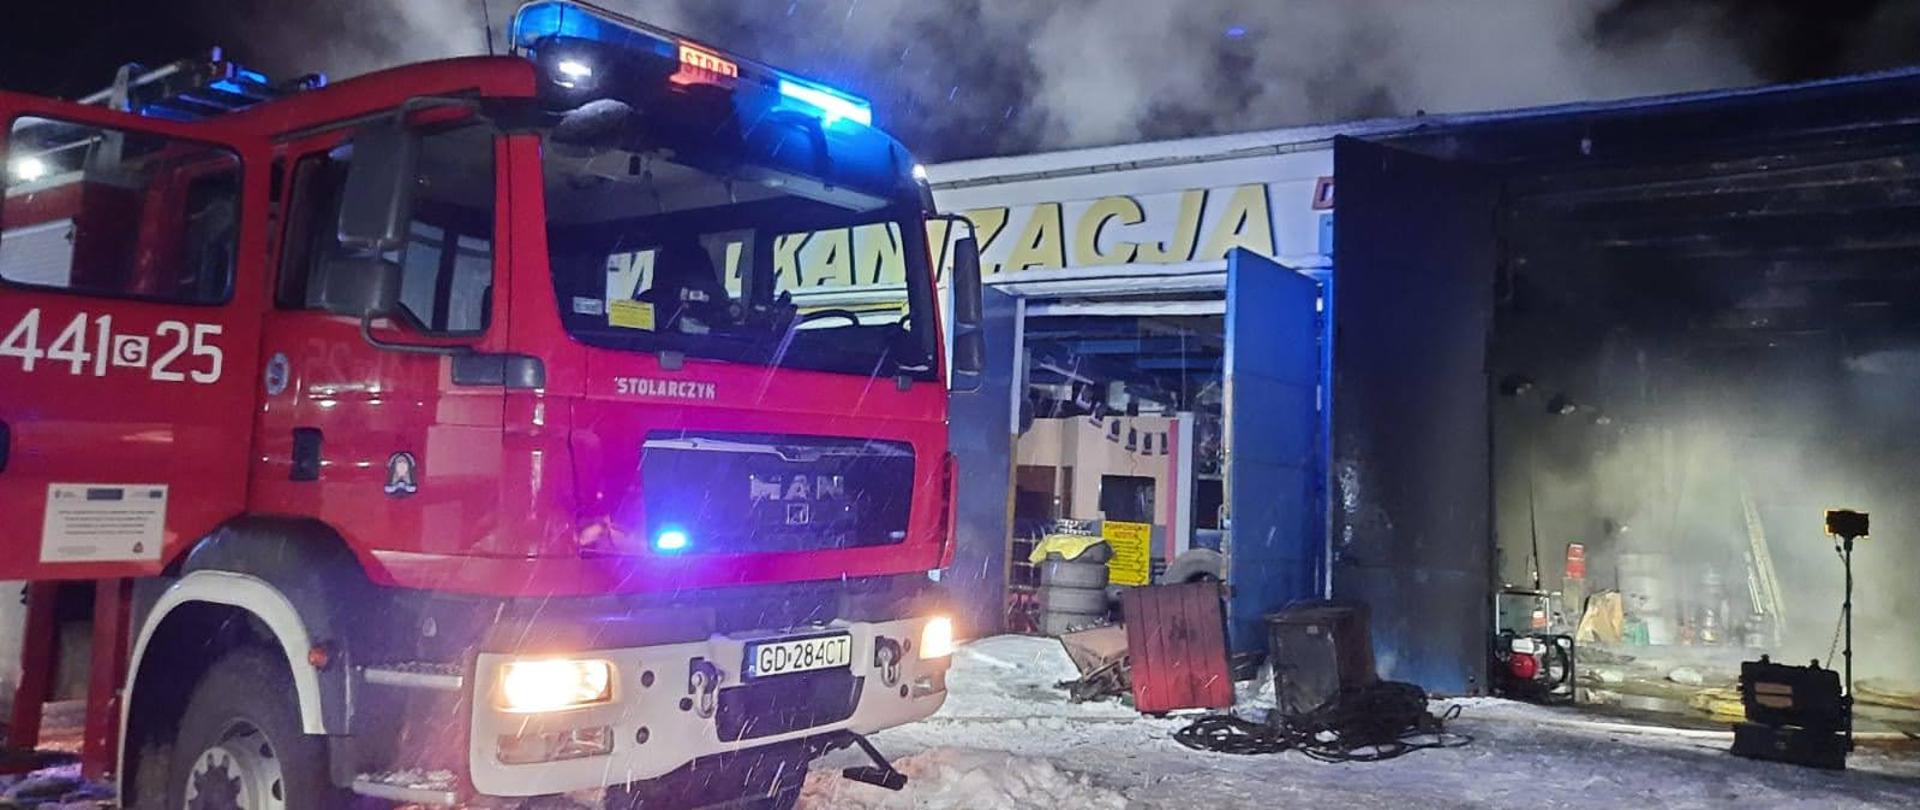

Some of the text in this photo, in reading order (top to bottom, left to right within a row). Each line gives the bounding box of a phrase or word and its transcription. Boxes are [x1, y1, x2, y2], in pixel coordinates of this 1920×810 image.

[612, 183, 1277, 299] WLKANIZACJA
[617, 377, 716, 399] STOLARCZYK
[750, 475, 845, 500] MAN
